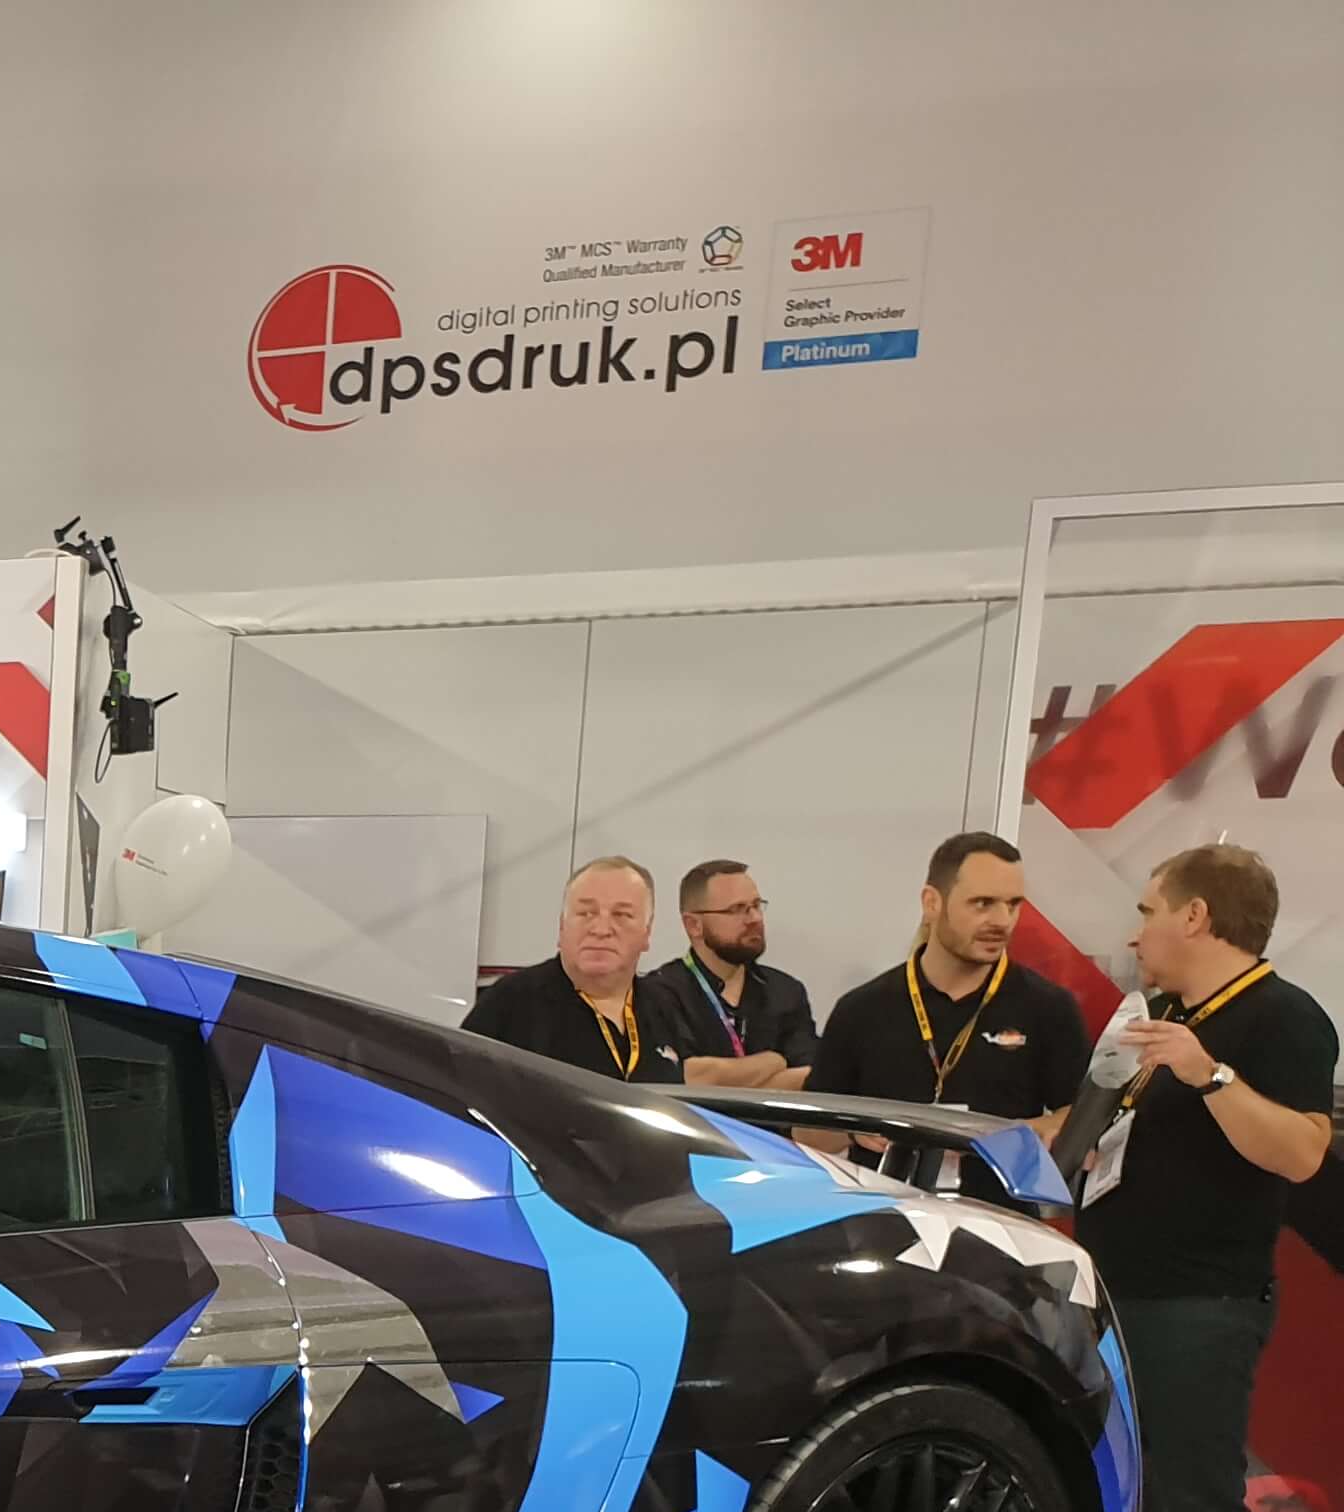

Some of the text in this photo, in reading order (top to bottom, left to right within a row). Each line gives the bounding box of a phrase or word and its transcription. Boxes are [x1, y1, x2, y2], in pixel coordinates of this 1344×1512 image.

[627, 236, 688, 254] Warranty
[791, 232, 863, 272] 3M
[543, 265, 597, 282] Qualified
[600, 258, 687, 277] Manufacturer
[436, 286, 742, 334] digital printing solutions
[785, 297, 831, 312] Select
[783, 307, 905, 328] Graphic Provider
[781, 341, 870, 363] Platinum
[329, 315, 739, 414] dpsdruk.pl
[1022, 676, 1344, 805] #W
